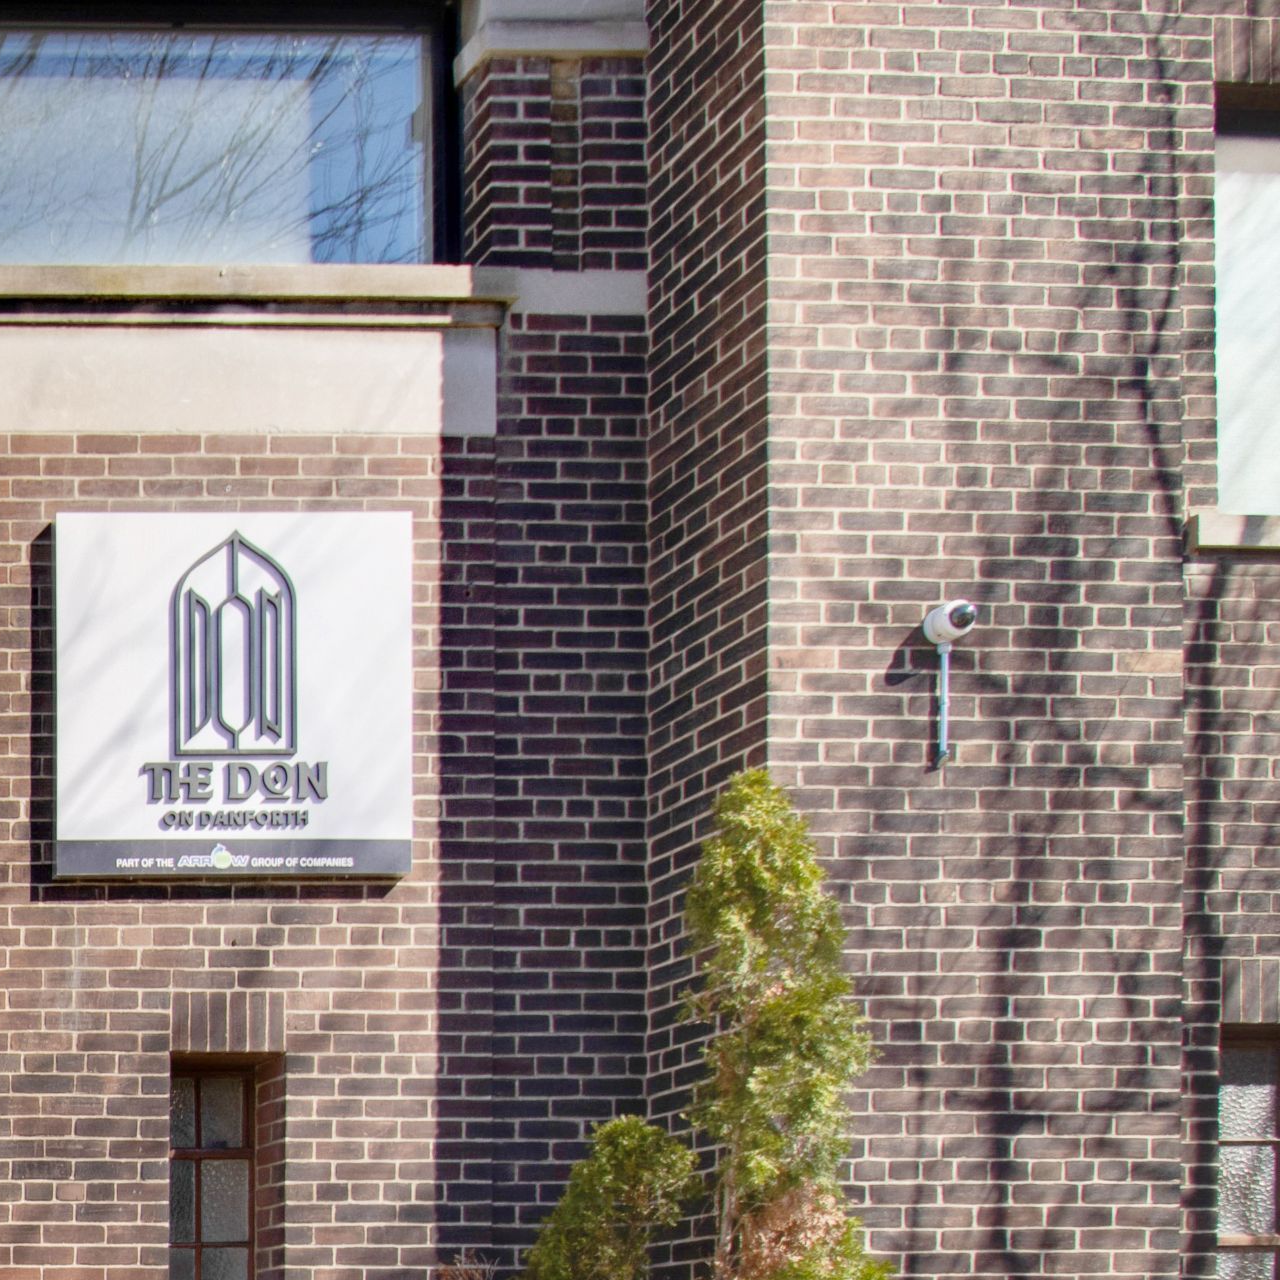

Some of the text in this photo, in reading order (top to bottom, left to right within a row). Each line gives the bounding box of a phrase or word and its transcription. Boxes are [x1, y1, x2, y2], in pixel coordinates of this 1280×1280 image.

[141, 762, 329, 802] THE DON
[160, 809, 309, 829] ON DANFORTH
[116, 849, 354, 869] PART OF THE ARROW GROUP OF COMPANIES
